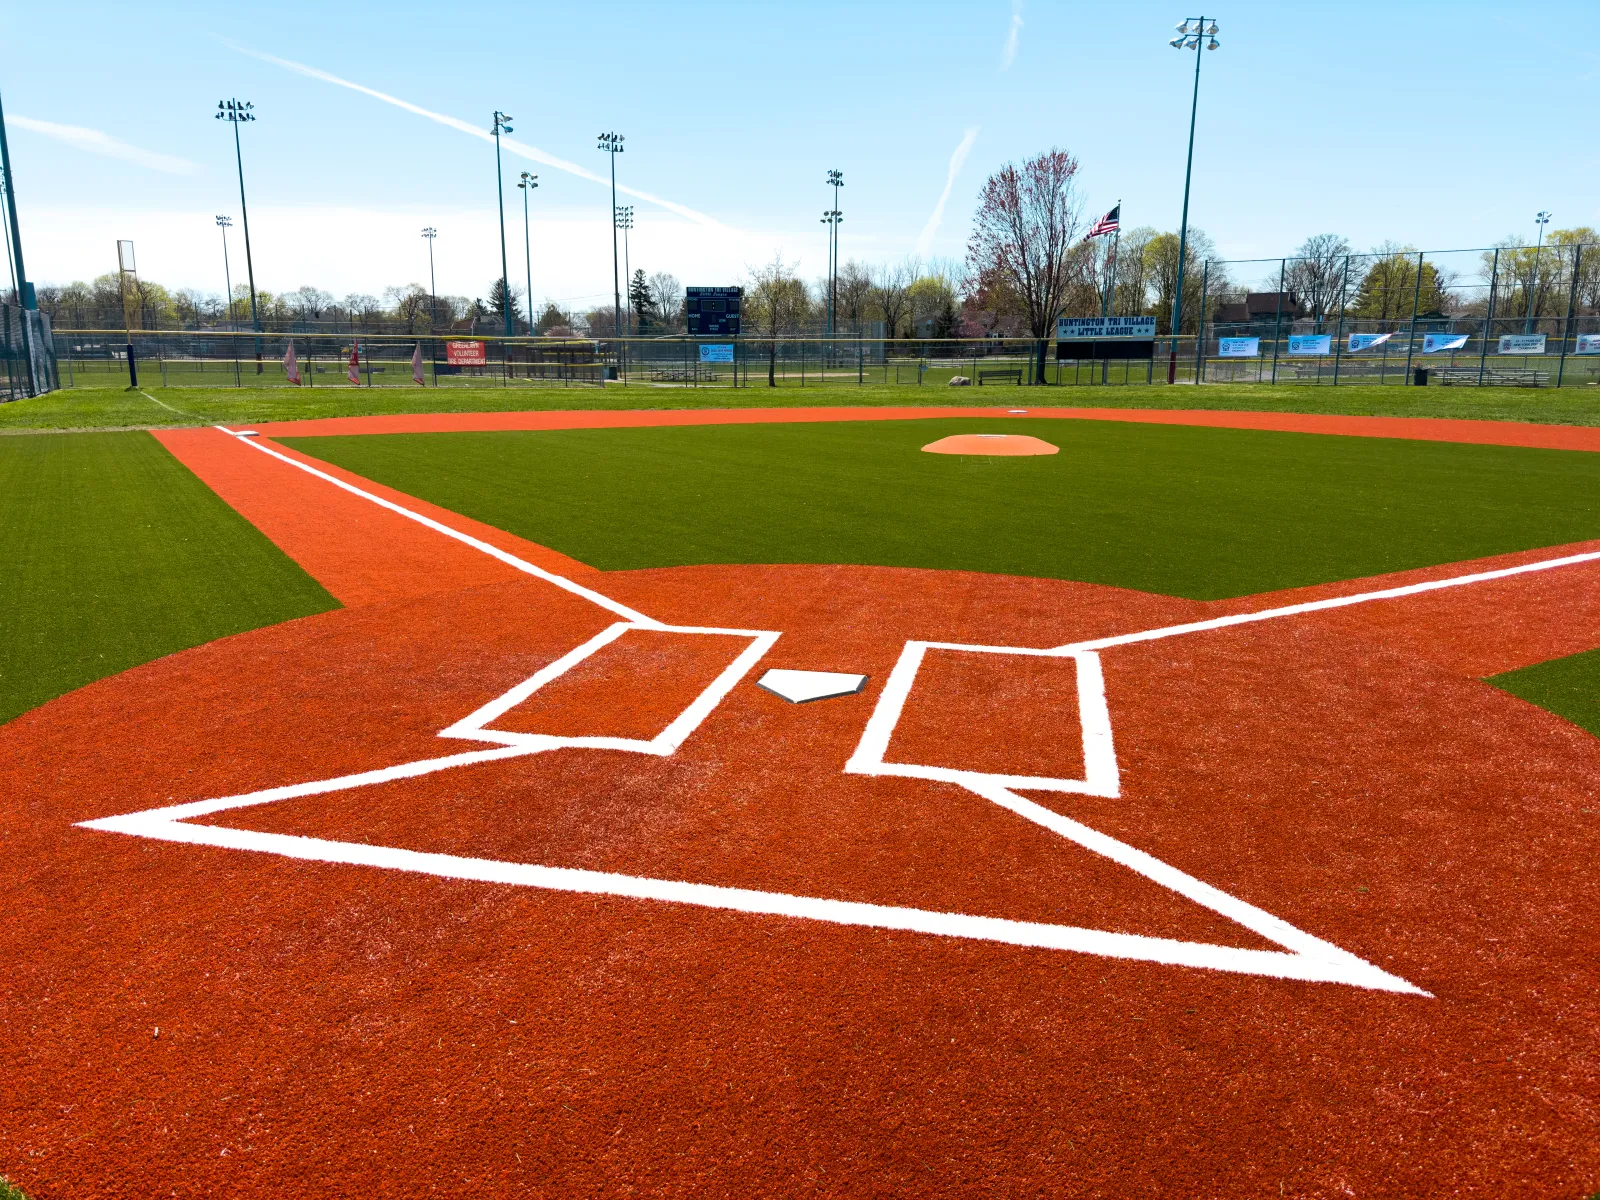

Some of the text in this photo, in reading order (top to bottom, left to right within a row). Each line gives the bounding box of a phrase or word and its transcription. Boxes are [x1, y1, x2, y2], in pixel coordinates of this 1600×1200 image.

[1058, 316, 1155, 327] HUNTINGTON TRI VILLAGE
[1077, 327, 1134, 336] LITTLE LEAGUE
